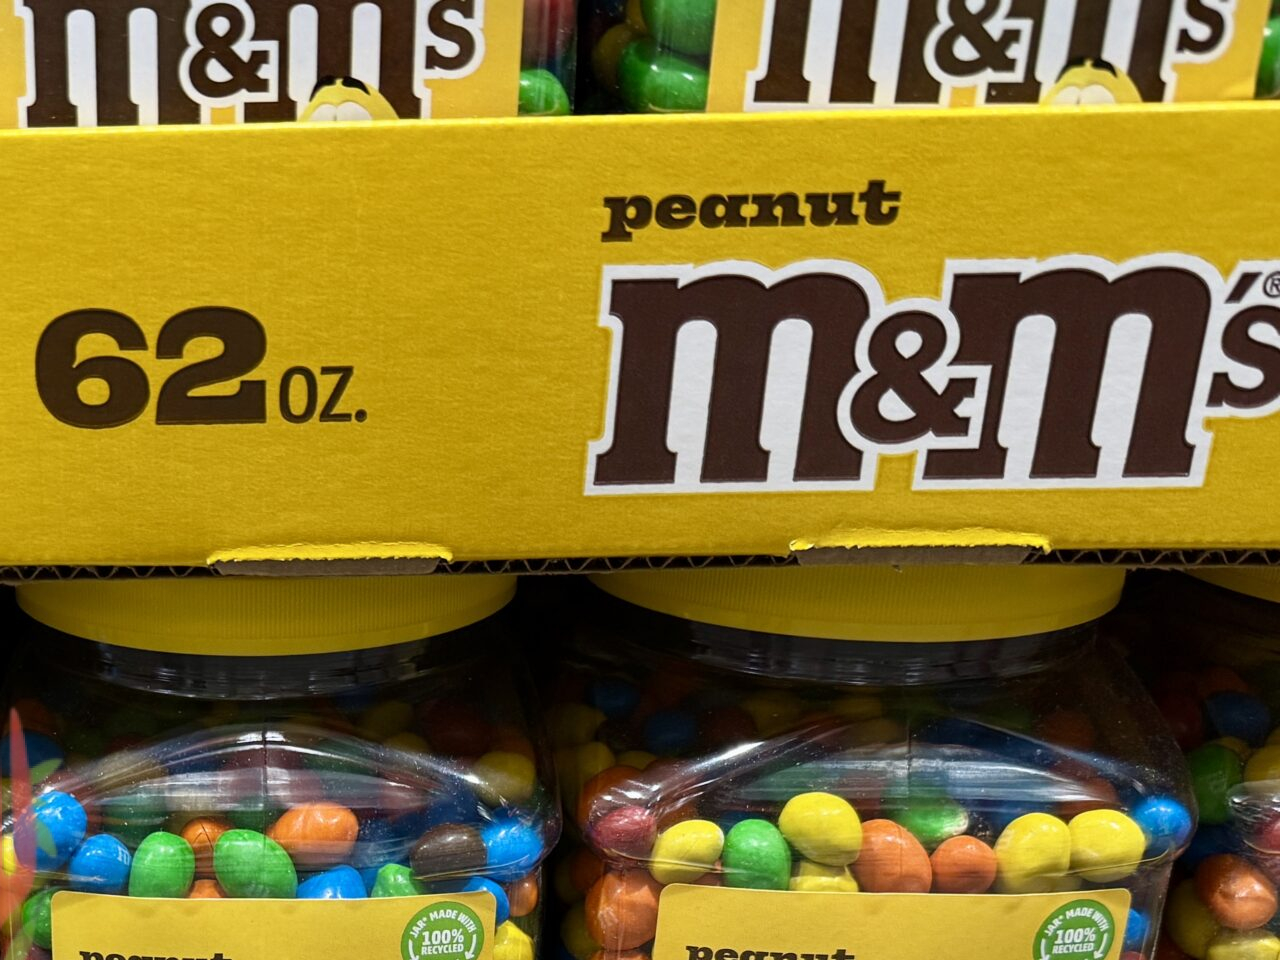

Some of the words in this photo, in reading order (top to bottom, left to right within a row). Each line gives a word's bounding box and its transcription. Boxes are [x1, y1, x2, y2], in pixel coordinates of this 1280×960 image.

[24, 0, 475, 125] m&ms
[601, 179, 902, 242] peanut
[35, 306, 266, 429] 62
[593, 266, 1280, 485] m&m's
[428, 908, 458, 921] MADE
[456, 912, 477, 933] WITH
[1065, 907, 1093, 920] MADE
[1091, 909, 1110, 932] WITH
[422, 929, 464, 946] 100%
[1055, 927, 1096, 943] 100%
[422, 943, 464, 956] RECYCLED
[1052, 942, 1095, 955] RECYCLED
